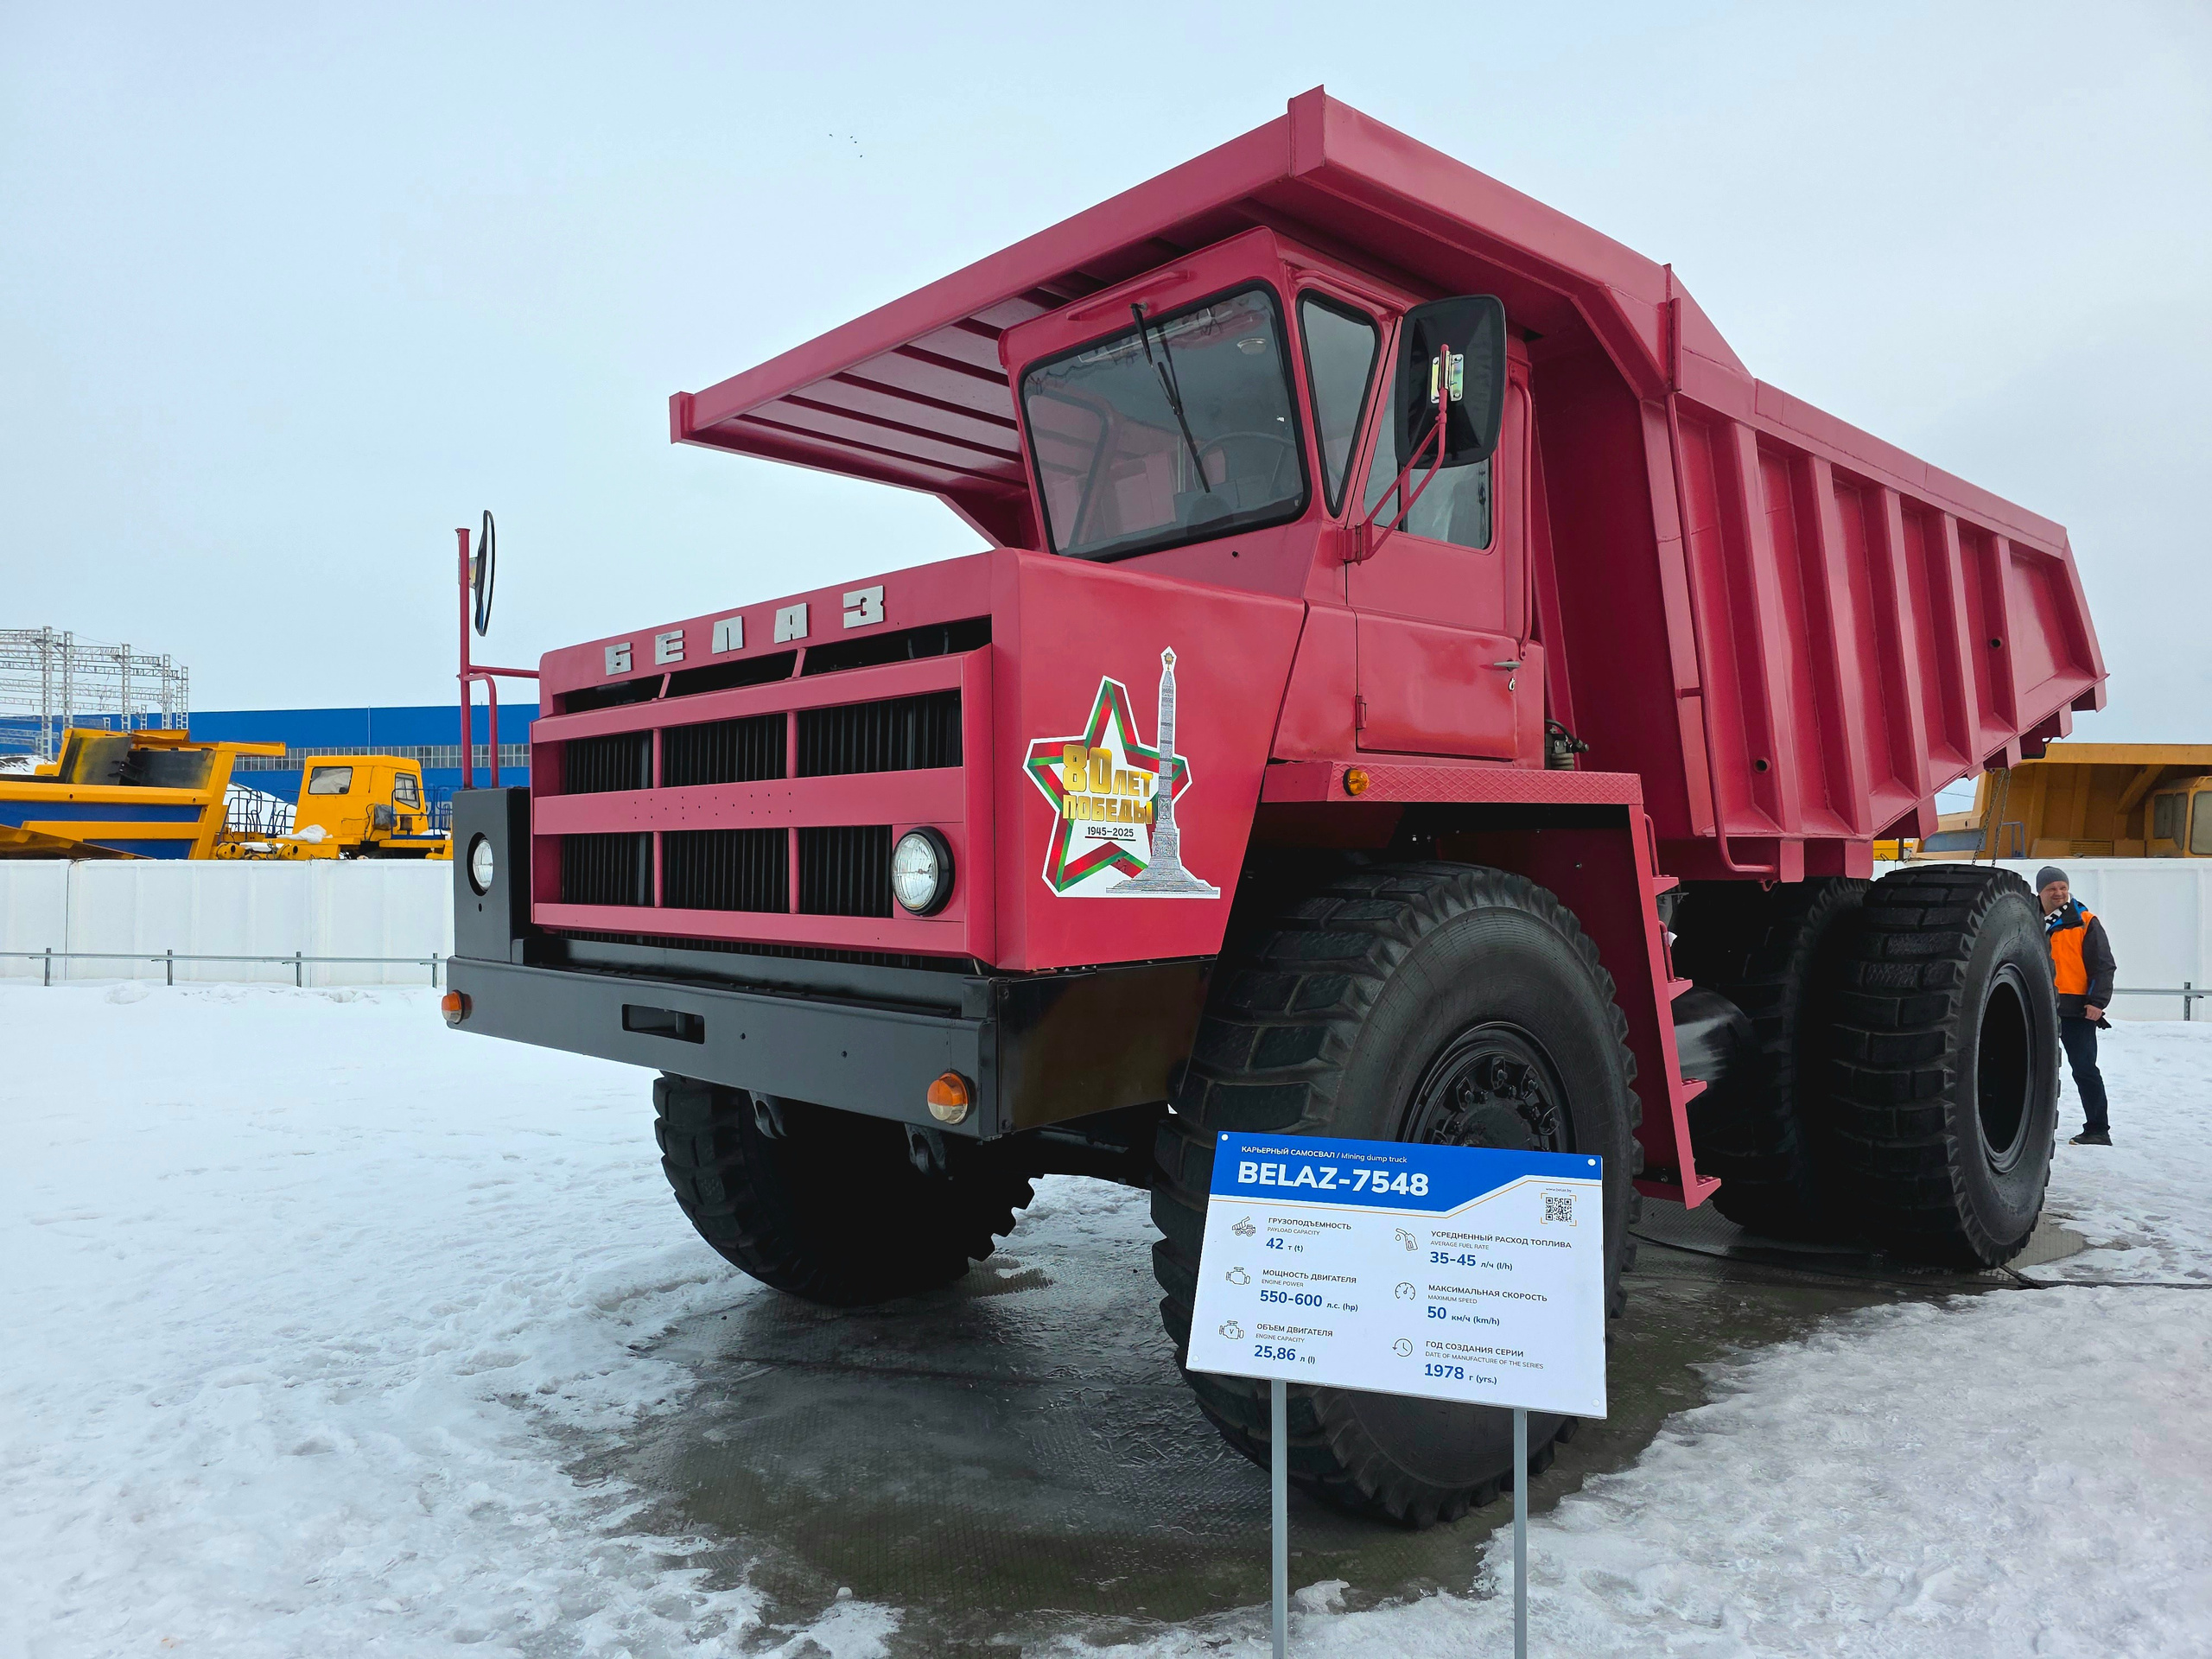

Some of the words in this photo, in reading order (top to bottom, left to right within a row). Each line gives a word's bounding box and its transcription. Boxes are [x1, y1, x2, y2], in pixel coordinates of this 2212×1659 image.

[605, 585, 884, 677] БЕЛАЗ
[1063, 744, 1113, 794] 80
[1113, 769, 1154, 798] ЛЕТ
[1063, 794, 1153, 824] ПОБЕДЫ
[1241, 1146, 1289, 1155] КАРЬЕРНЫЙ
[1290, 1149, 1335, 1159] САМОСВАЛ
[1341, 1153, 1365, 1161] Mining
[1366, 1154, 1388, 1163] dump
[1237, 1160, 1429, 1197] BELAZ-7548
[1268, 1217, 1351, 1230] ГРУЗОПОДЪЕМНОСТЬ
[1266, 1237, 1284, 1249] 42
[1294, 1244, 1304, 1253] (t)
[1431, 1230, 1493, 1242] УСРЕДНЕННЫЙ
[1495, 1236, 1529, 1246] РАСХОД
[1530, 1238, 1572, 1249] ТОПЛИВА
[1429, 1251, 1477, 1267] 35-45
[1497, 1262, 1513, 1271] (l/h)
[1262, 1269, 1309, 1279] МОЩНОСТЬ
[1310, 1274, 1357, 1283] ДВИГАТЕЛЯ
[1260, 1289, 1323, 1307] 550-600
[1343, 1303, 1358, 1312] (hp)
[1428, 1284, 1500, 1297] МАКСИМАЛЬНАЯ
[1502, 1291, 1548, 1302] СКОРОСТЬ
[1427, 1306, 1446, 1319] 50
[1473, 1316, 1500, 1326] (km/h)
[1256, 1323, 1285, 1332] ОБЪЕМ
[1286, 1325, 1333, 1337] ДВИГАТЕЛЯ
[1254, 1344, 1296, 1361] 25,86
[1426, 1340, 1443, 1350] ГОД
[1445, 1343, 1493, 1354] СОЗДАНИЯ
[1495, 1348, 1524, 1357] СЕРИИ
[1452, 1354, 1497, 1364] MANUFACTURE
[1424, 1363, 1465, 1380] 1978
[1476, 1375, 1497, 1385] (yrs.)
